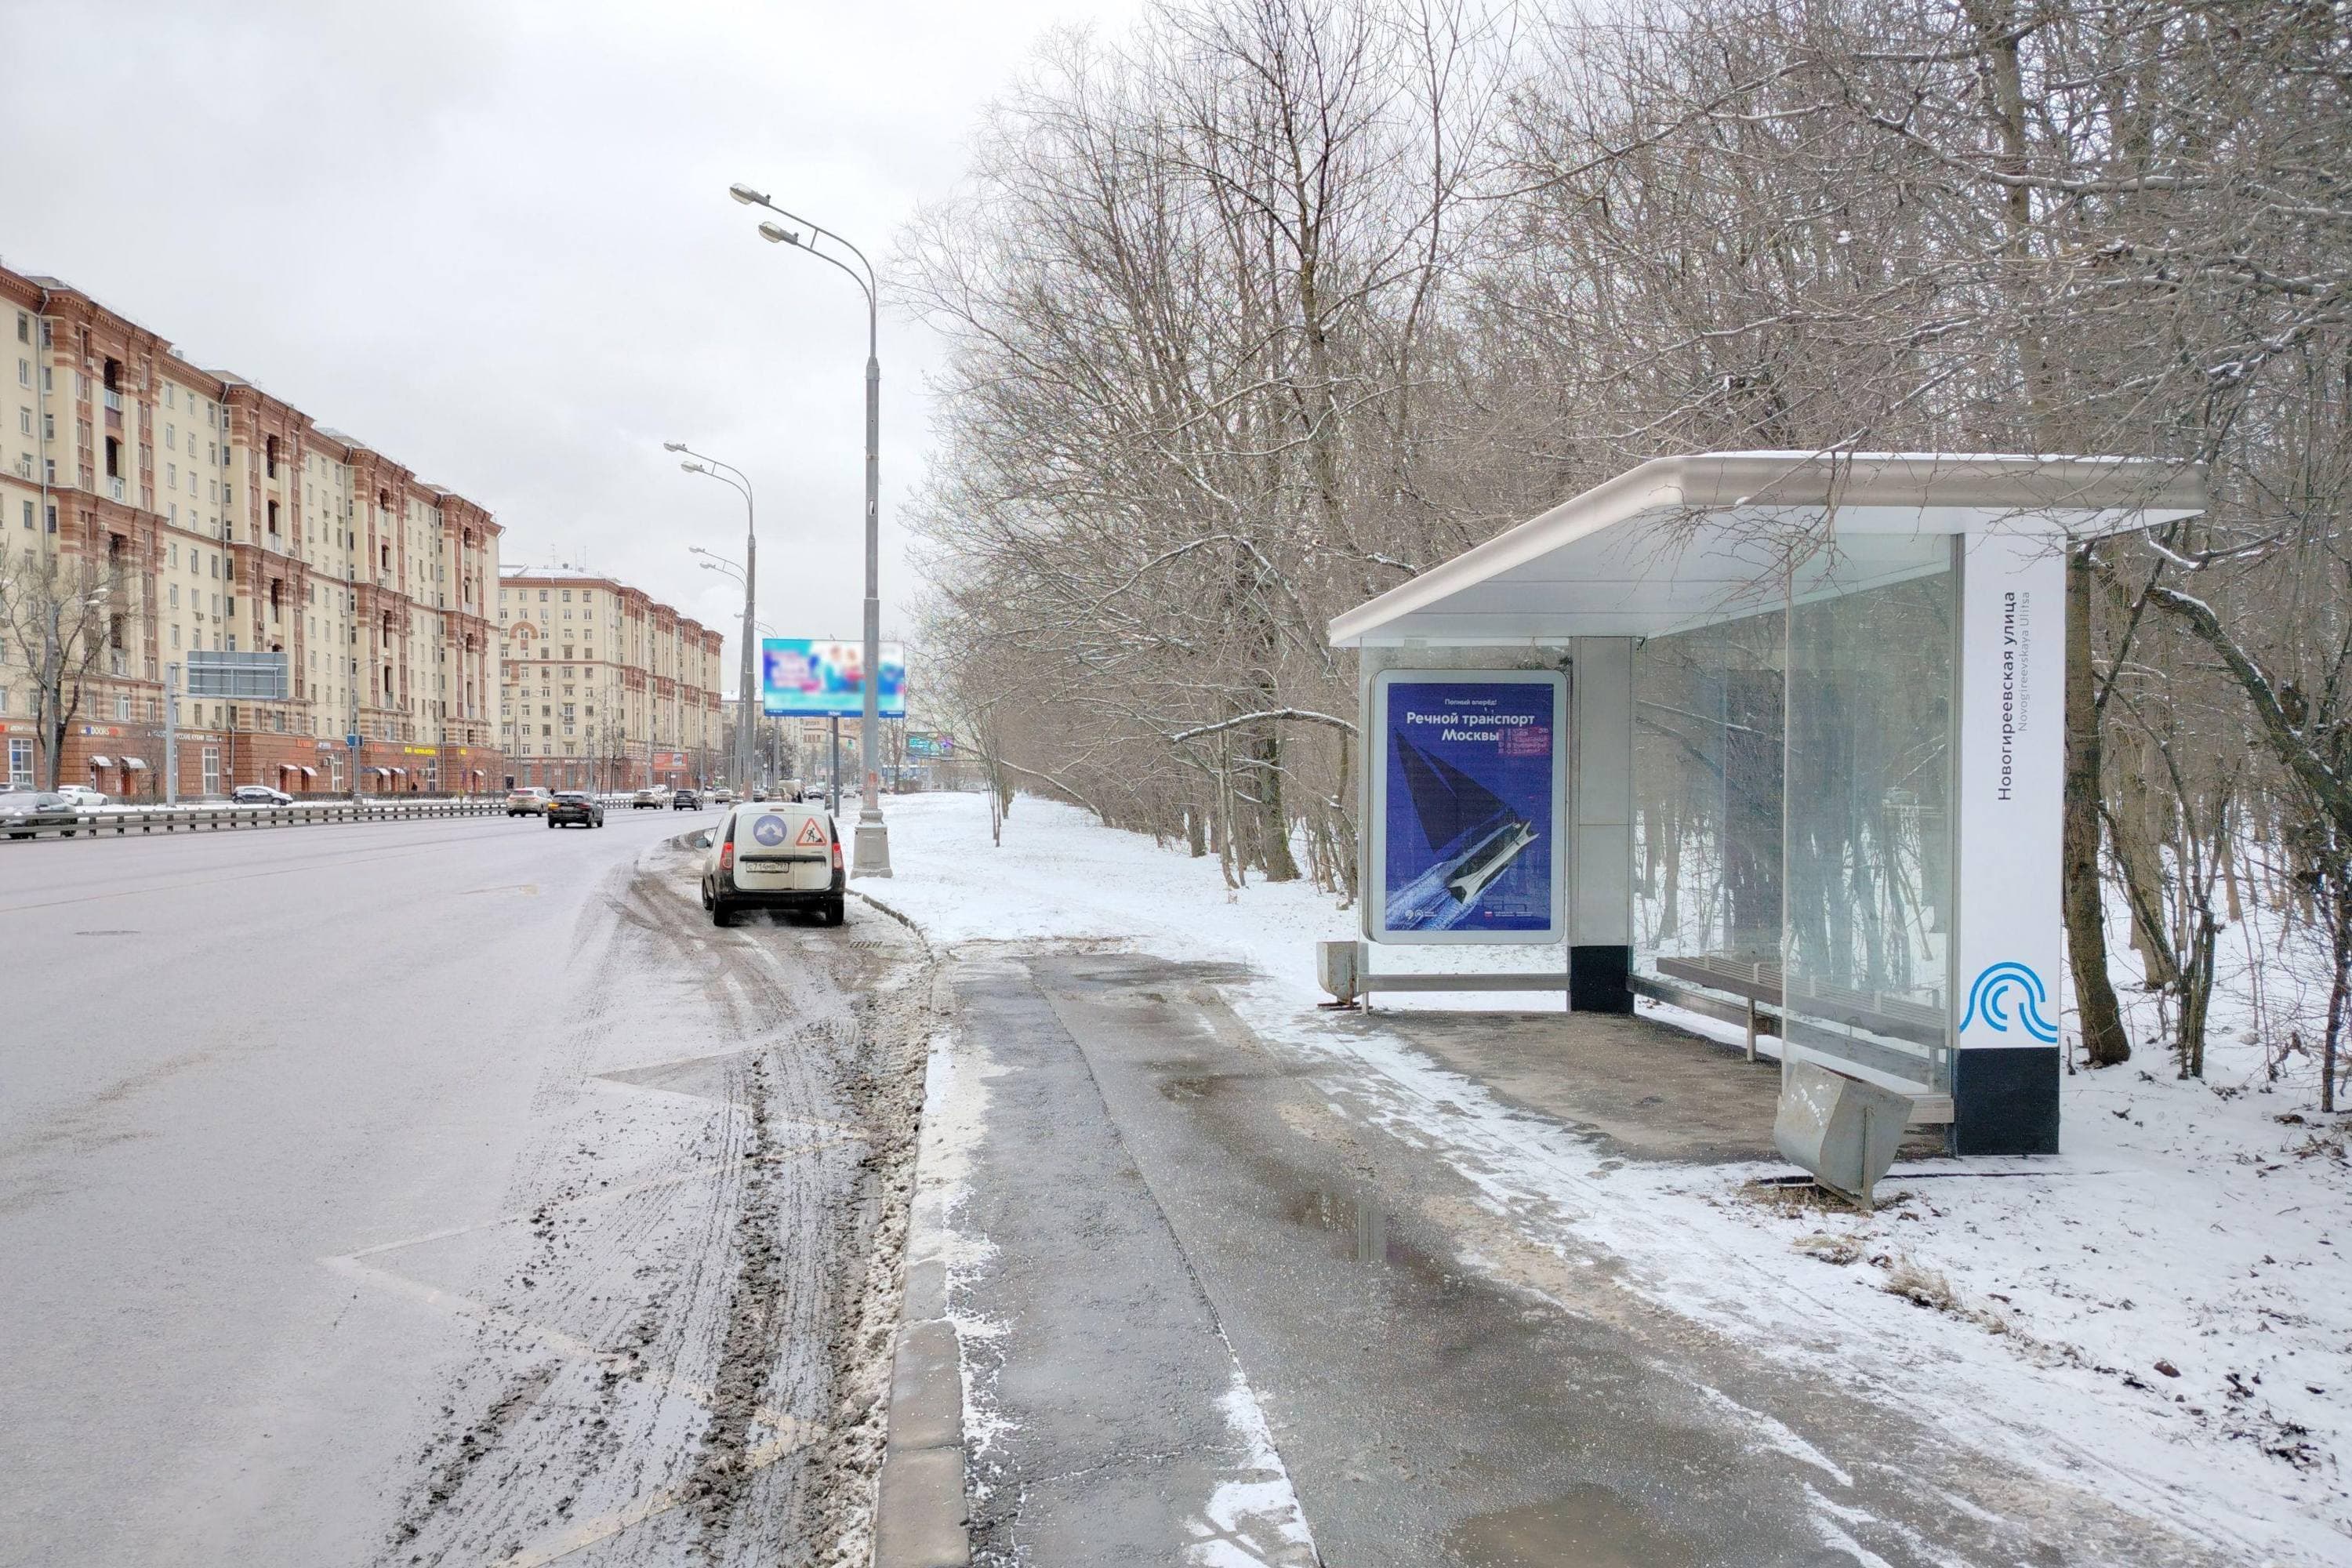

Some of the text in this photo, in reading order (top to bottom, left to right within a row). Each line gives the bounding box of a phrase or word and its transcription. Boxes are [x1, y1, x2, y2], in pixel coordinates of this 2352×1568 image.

[2018, 591, 2031, 731] Novogireevskaya Ulitsa
[1444, 698, 1470, 706] Полный
[1998, 591, 2017, 800] Новогиреевская улица
[1406, 711, 1535, 727] Речной транспорт
[1441, 728, 1499, 742] Москвы
